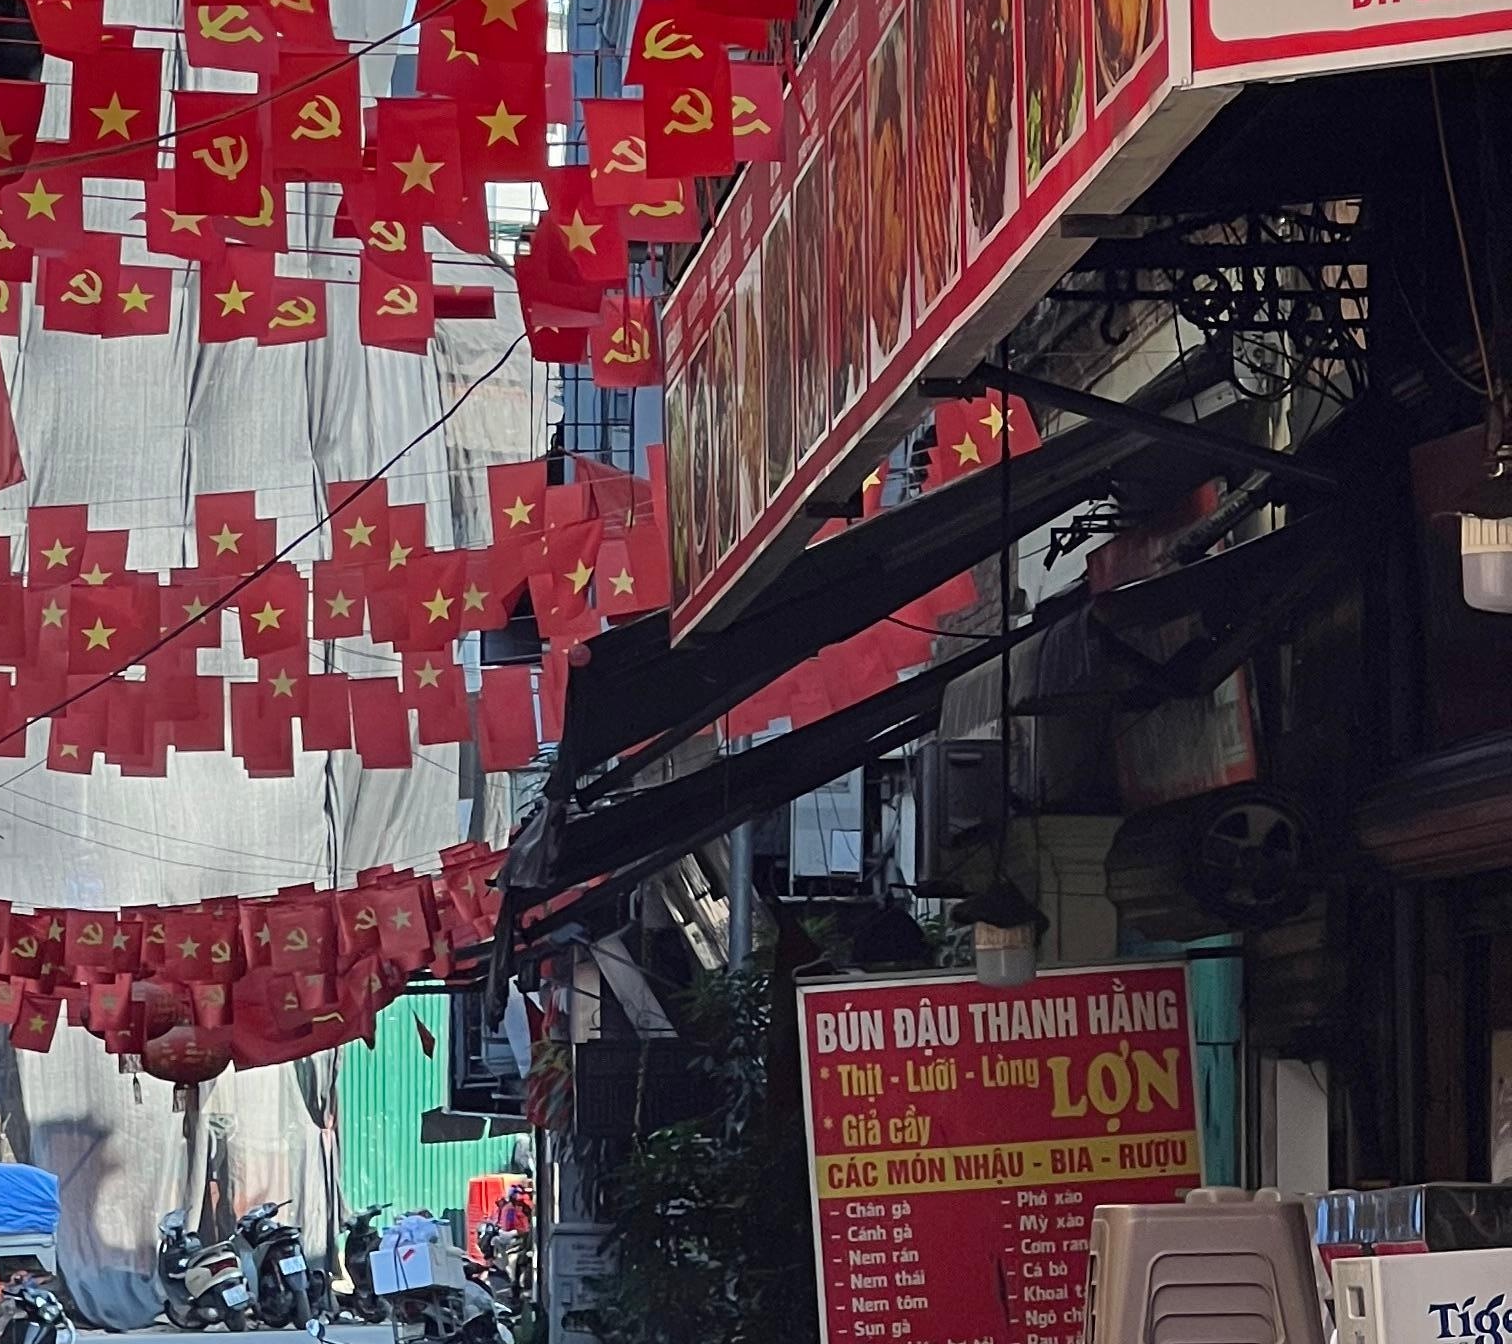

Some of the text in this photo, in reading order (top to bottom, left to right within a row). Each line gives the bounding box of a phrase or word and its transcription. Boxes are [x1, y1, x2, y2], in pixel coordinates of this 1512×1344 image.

[816, 978, 1178, 1056] BÚN ĐẬU THANH HẰNG
[838, 1064, 883, 1102] Thịt
[907, 1058, 957, 1093] Lưỡi
[983, 1054, 1039, 1089] Lòng
[1047, 1040, 1180, 1133] LỢN
[842, 1104, 931, 1147] Giả cầy
[827, 1157, 878, 1190] CÁC
[888, 1153, 947, 1186] MÓN
[955, 1149, 1024, 1185] NHẬU
[1050, 1147, 1093, 1174] BIA
[1119, 1140, 1187, 1174] RƯỢU
[1054, 1189, 1083, 1205] xào
[846, 1200, 911, 1219] Chân gà
[848, 1224, 913, 1243] Cánh gà
[1063, 1239, 1088, 1252] ran
[849, 1248, 919, 1265] Nem rán
[850, 1270, 925, 1289] Nem thái
[1024, 1286, 1068, 1302] Khoai
[852, 1295, 928, 1313] Nem tôm
[892, 1319, 911, 1338] gà
